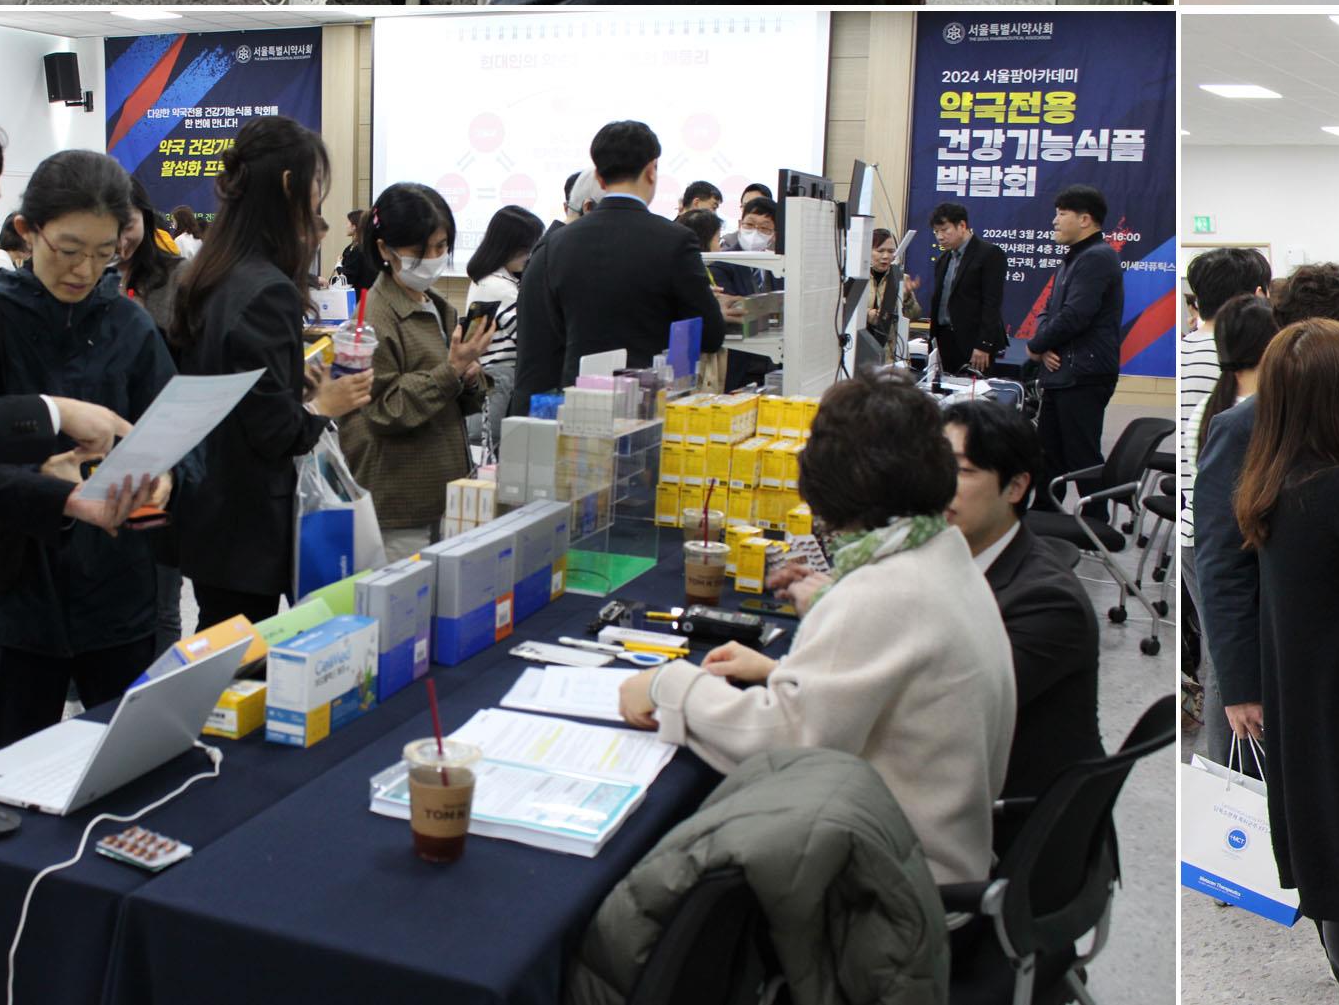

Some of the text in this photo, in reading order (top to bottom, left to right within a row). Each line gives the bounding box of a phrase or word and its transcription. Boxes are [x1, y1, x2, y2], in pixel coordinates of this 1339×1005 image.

[968, 22, 1054, 36] 서울특별시약사회
[253, 44, 312, 56] 서울특별시약사회
[942, 68, 1078, 84] 2024 서울팜아카데미
[147, 108, 170, 118] 다양한
[172, 108, 203, 117] 약국전용
[204, 106, 252, 117] 건강기능식품
[940, 91, 1077, 124] 약국전용
[184, 118, 238, 128] 한 번에 만나다!
[159, 139, 185, 155] 약국
[937, 128, 1146, 162] 건강기능식품
[161, 160, 202, 177] 활성화
[936, 164, 1038, 197] 박람회
[983, 229, 1017, 239] 2024년
[1019, 230, 1034, 239] 3월
[1037, 244, 1052, 254] 4층
